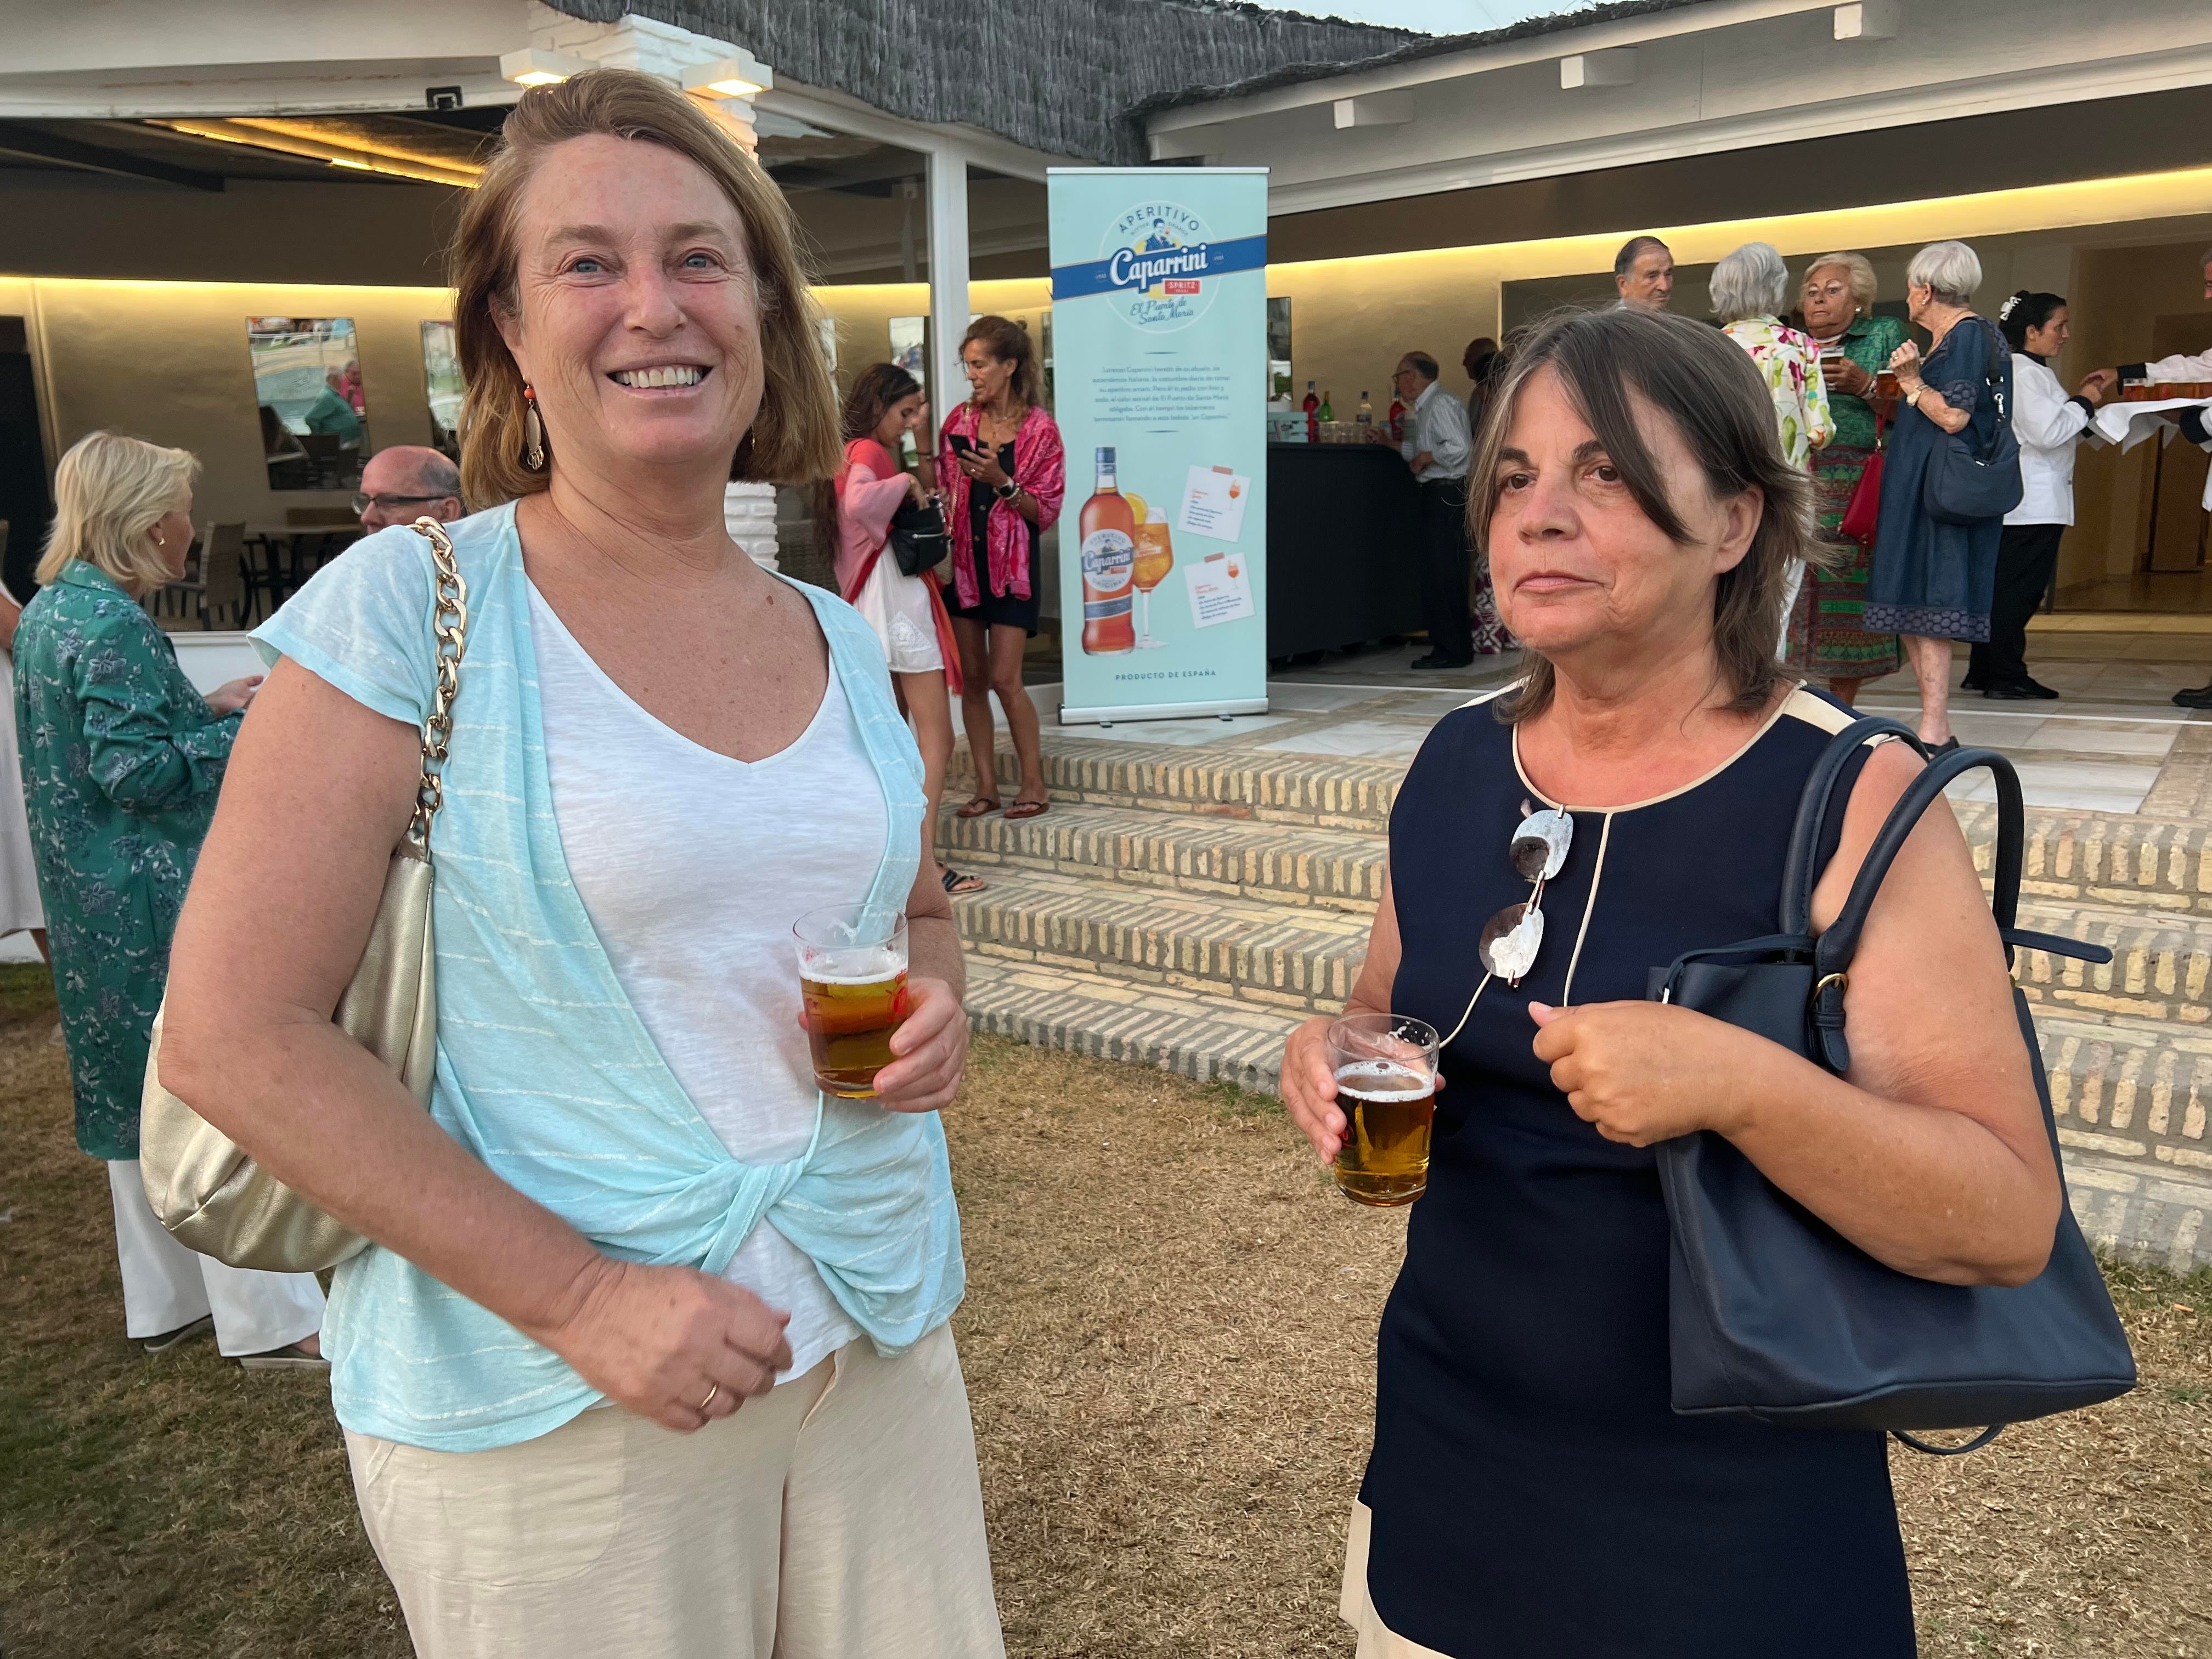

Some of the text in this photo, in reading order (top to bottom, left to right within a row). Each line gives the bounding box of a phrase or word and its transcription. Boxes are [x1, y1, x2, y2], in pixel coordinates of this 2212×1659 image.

[1119, 206, 1199, 235] APERITIVO
[1109, 244, 1209, 291] Caparrini
[1138, 312, 1165, 325] Santa
[1085, 549, 1131, 572] Caparrini
[1115, 672, 1165, 681] PRODUCTO
[1182, 667, 1216, 678] ESPAÑA
